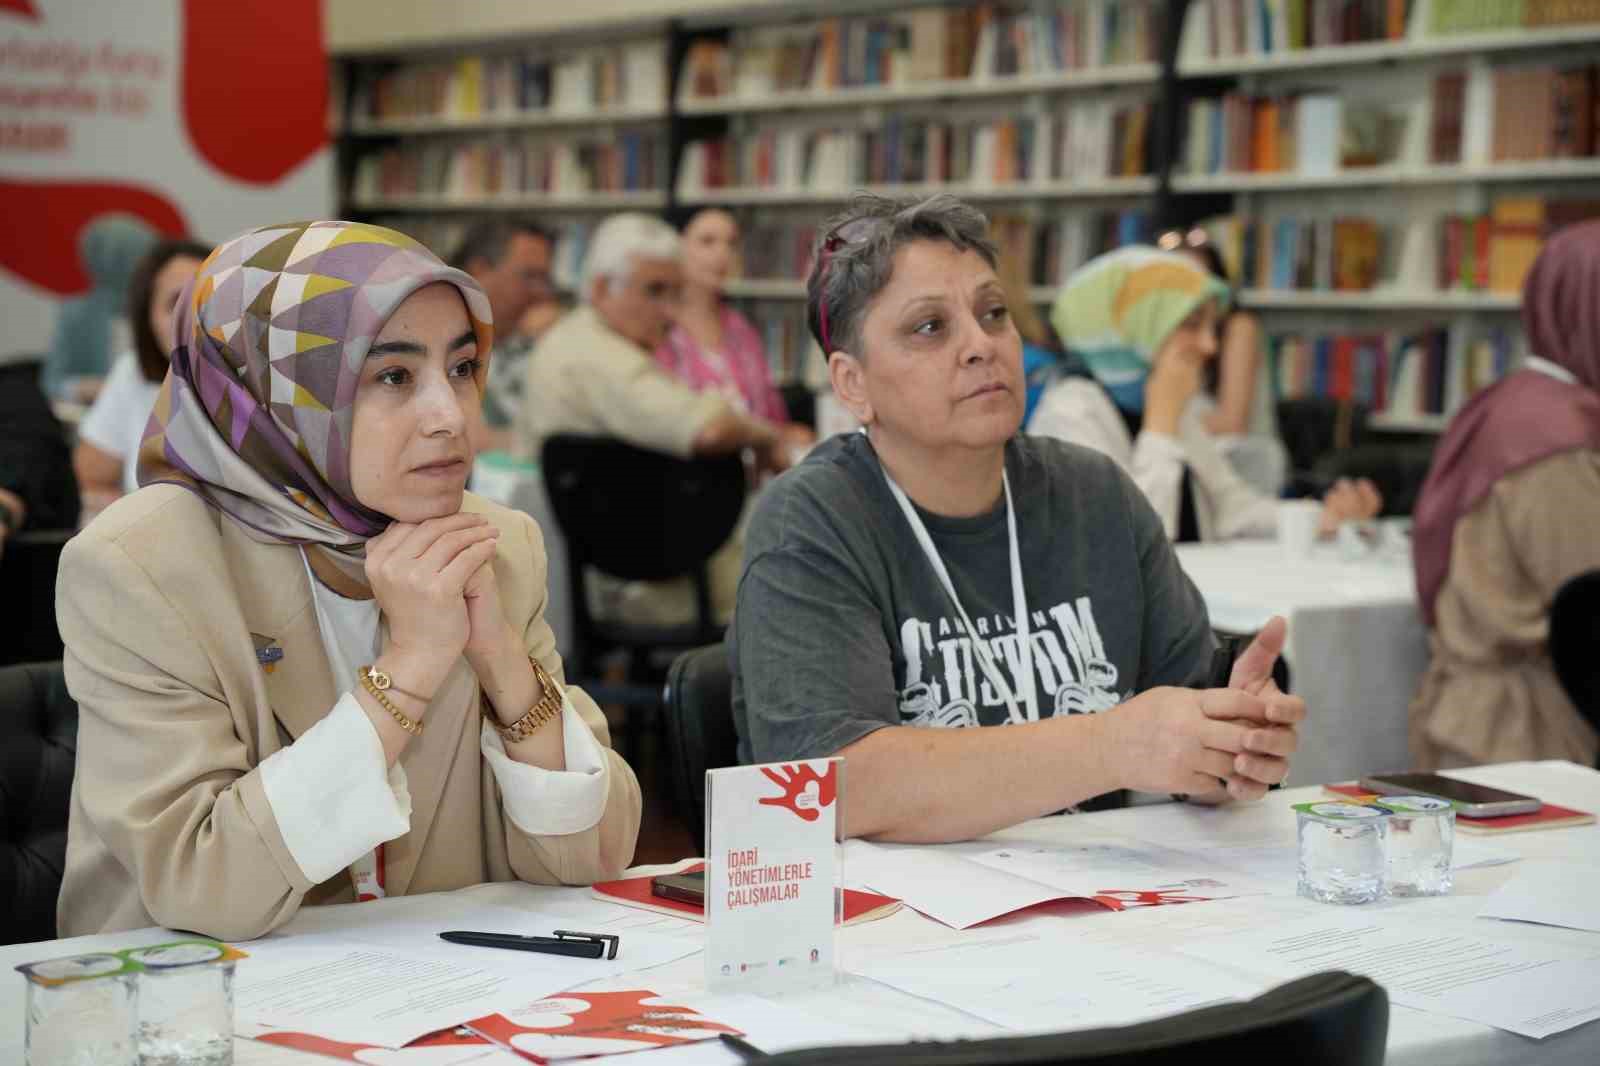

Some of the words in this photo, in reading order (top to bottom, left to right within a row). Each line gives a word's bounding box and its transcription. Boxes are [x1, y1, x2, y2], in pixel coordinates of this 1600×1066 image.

[728, 847, 758, 869] İDARİ
[728, 862, 812, 888] YÖNETİMLERLE
[727, 884, 799, 910] ÇALIŞMALAR
